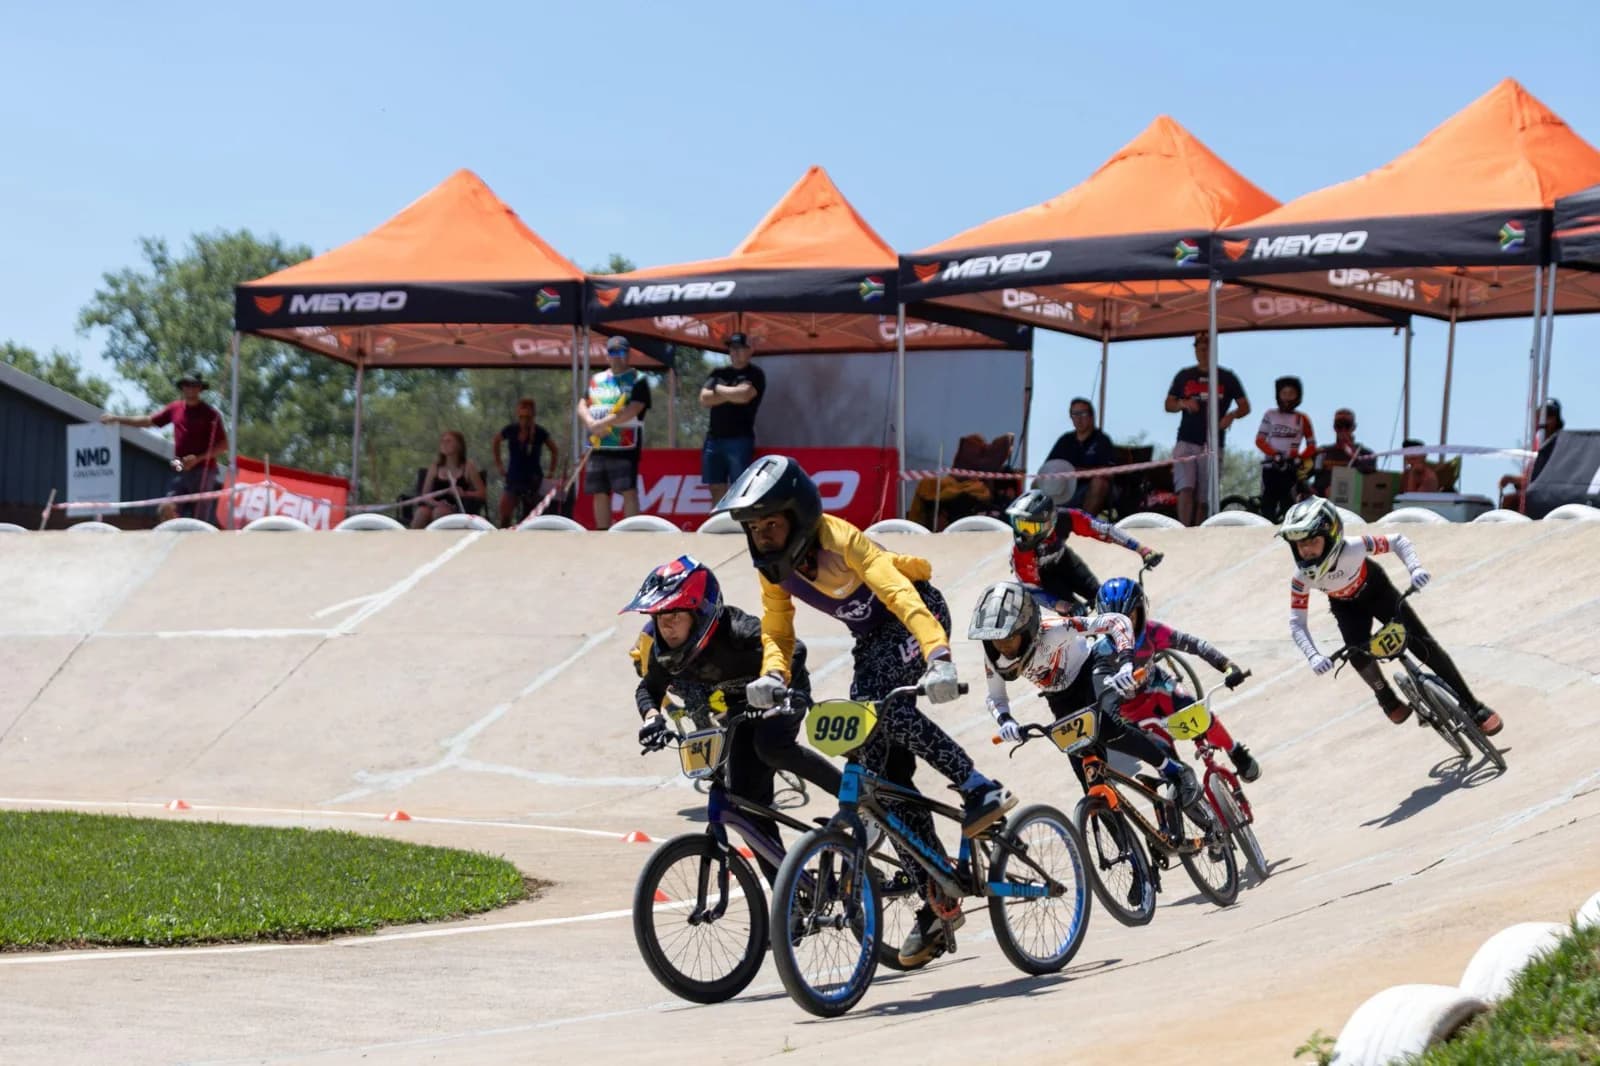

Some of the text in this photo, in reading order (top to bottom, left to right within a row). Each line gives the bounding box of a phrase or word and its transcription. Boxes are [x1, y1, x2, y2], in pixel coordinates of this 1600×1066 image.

[1252, 231, 1368, 259] MEYBO
[942, 251, 1051, 280] MEYBO
[289, 291, 407, 313] MEYBO
[623, 280, 736, 305] MEYBO
[76, 447, 110, 467] NMD
[1378, 629, 1403, 655] 121
[814, 715, 860, 741] 998
[1073, 718, 1087, 738] 2
[1179, 716, 1198, 734] 31
[703, 738, 712, 765] 1
